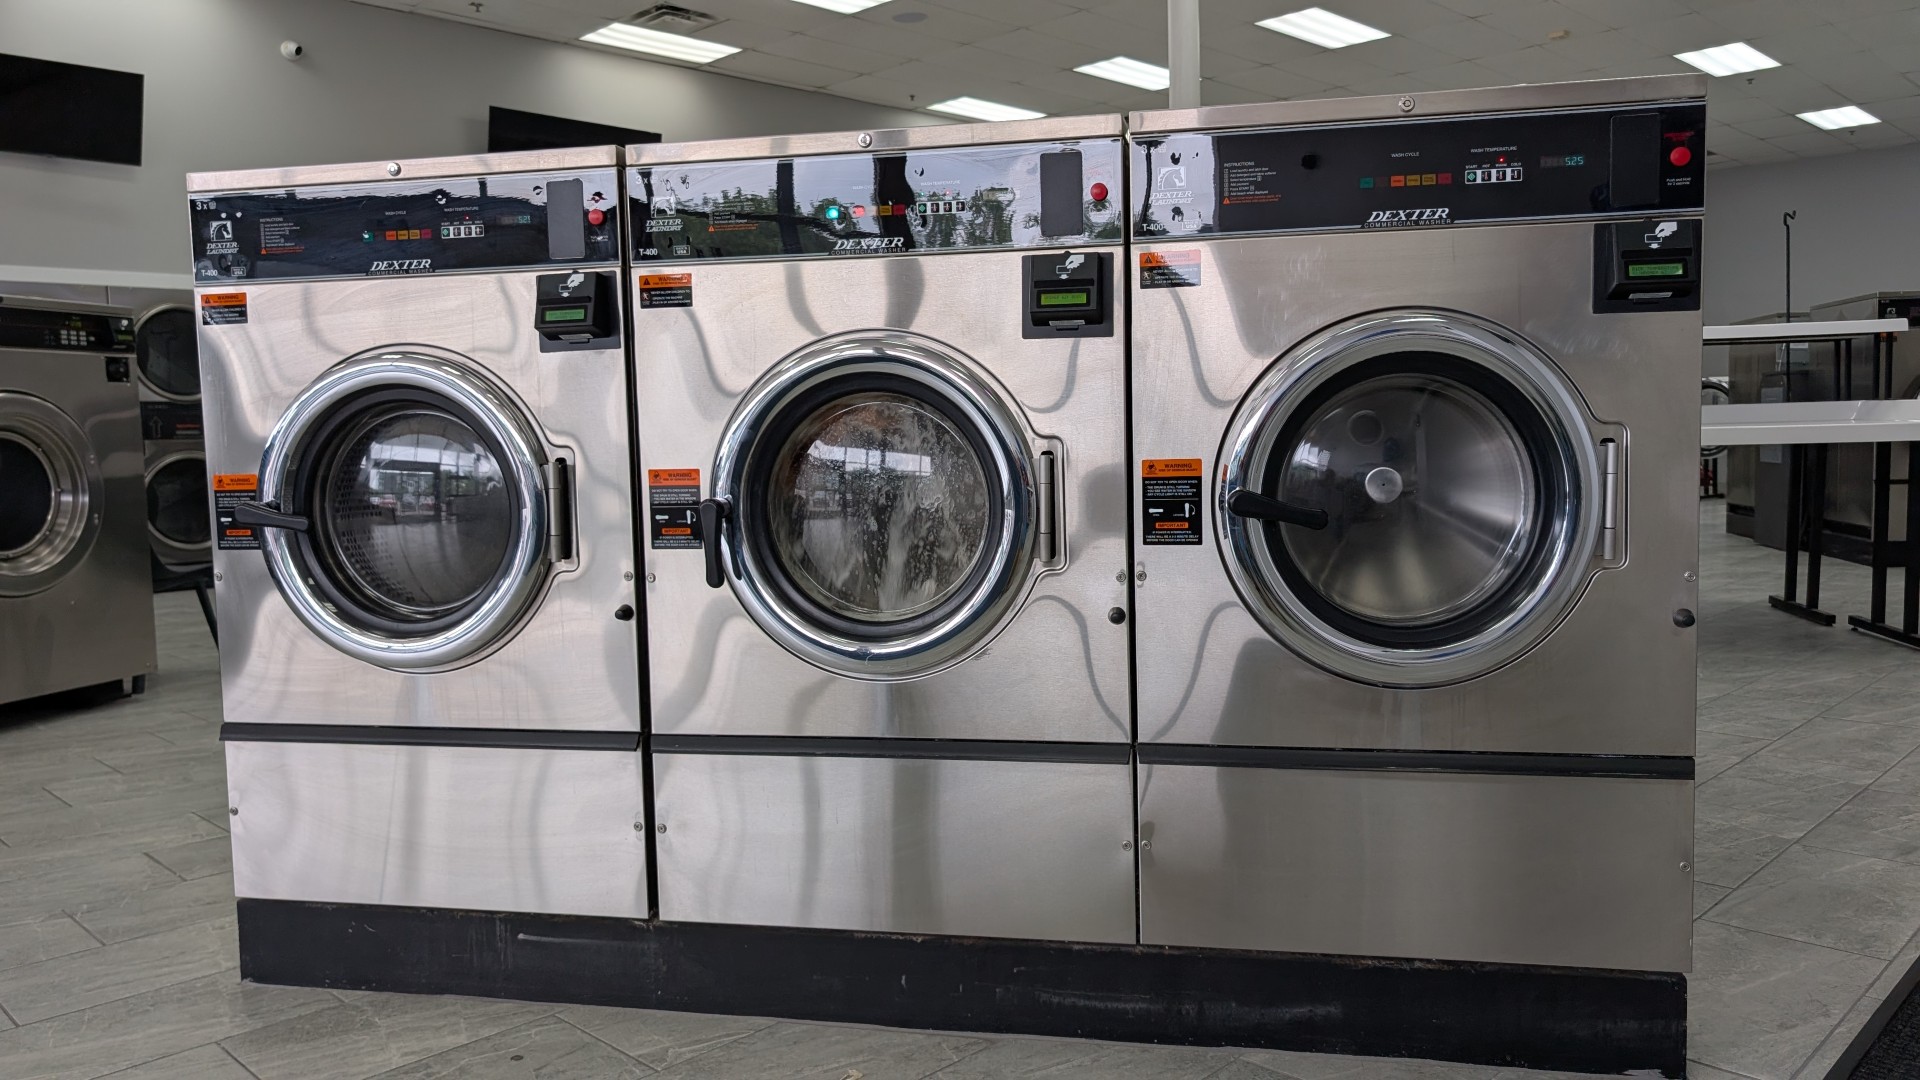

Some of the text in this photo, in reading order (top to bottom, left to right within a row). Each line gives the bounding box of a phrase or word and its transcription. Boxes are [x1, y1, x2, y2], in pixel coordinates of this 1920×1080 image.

[1565, 156, 1584, 166] 525
[1151, 191, 1192, 199] DEXTER
[196, 202, 202, 210] 3
[1366, 207, 1450, 222] DEXTER
[1142, 223, 1164, 231] T-400
[833, 237, 904, 250] DEXTER
[639, 248, 658, 256] T-400
[370, 259, 431, 271] DEXTER
